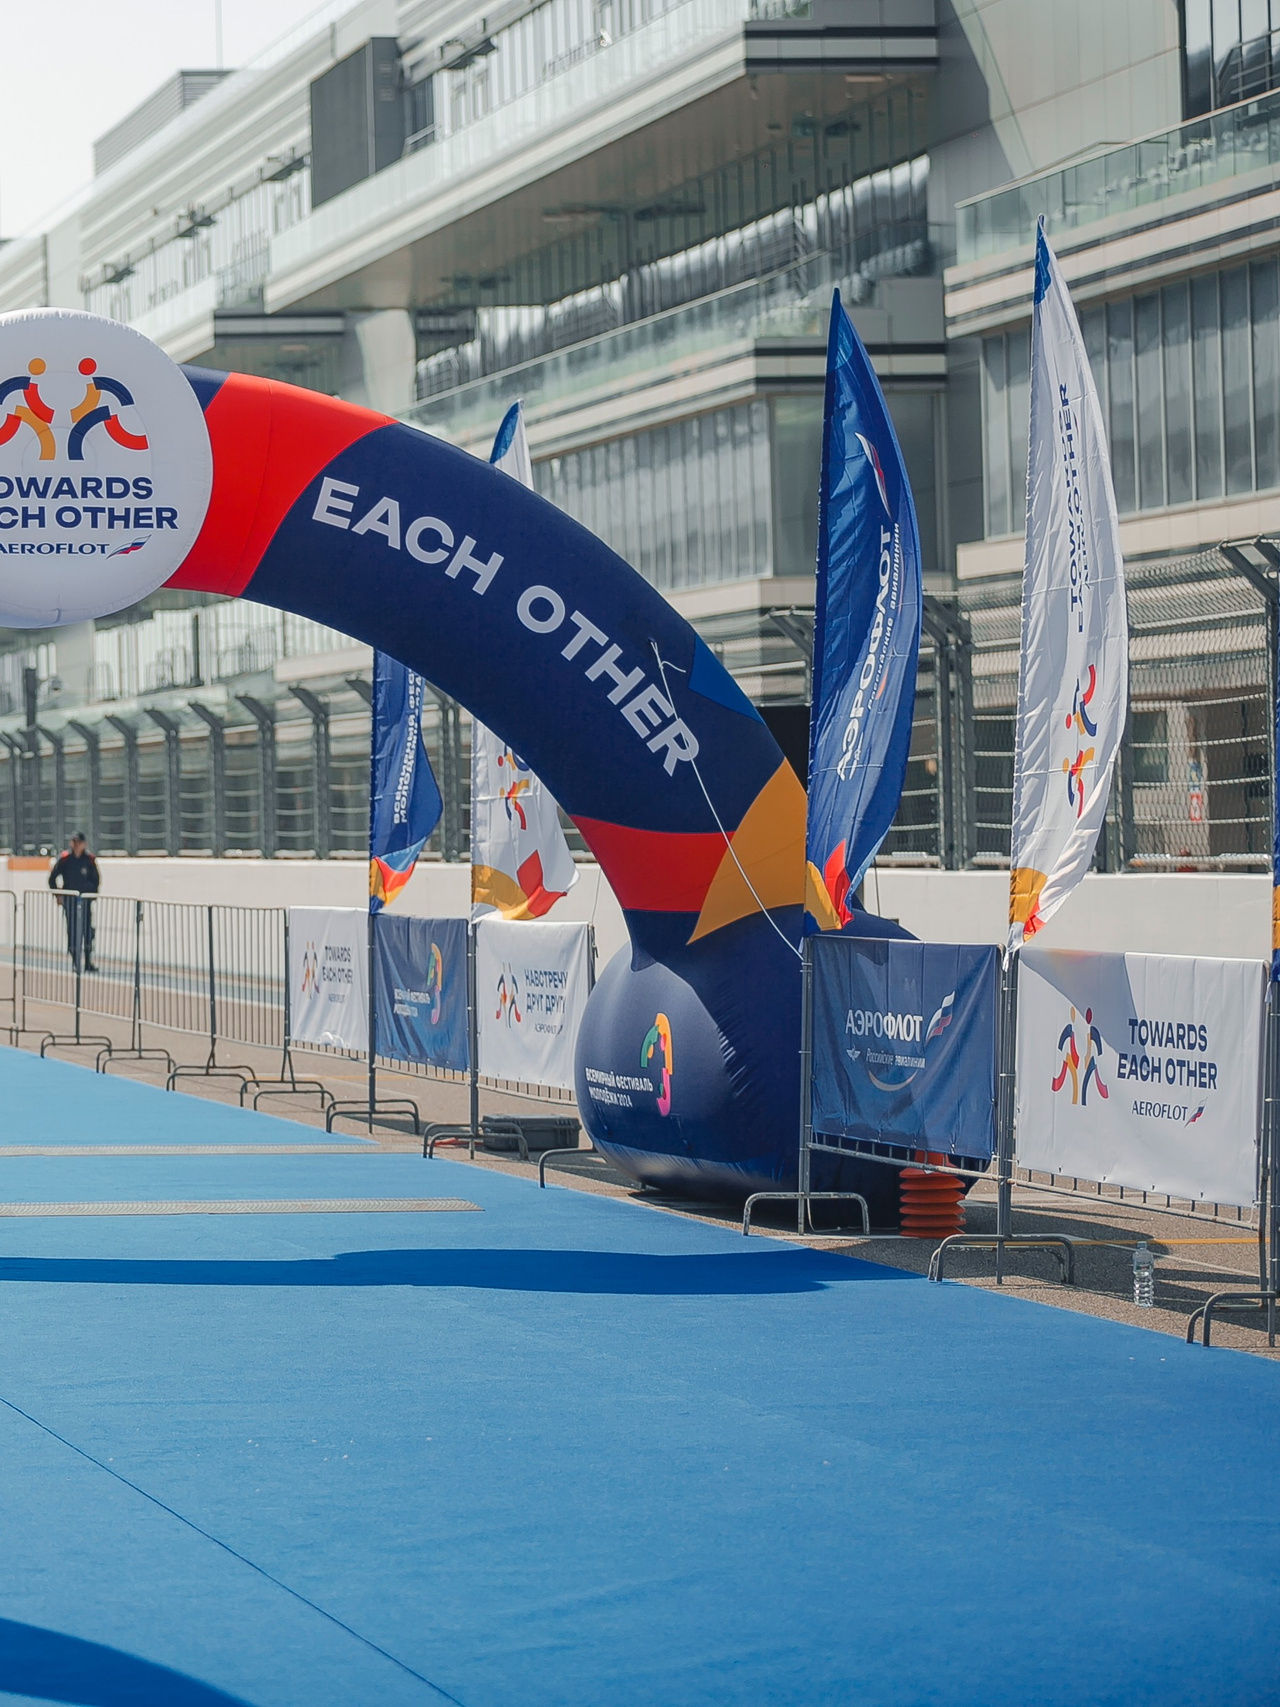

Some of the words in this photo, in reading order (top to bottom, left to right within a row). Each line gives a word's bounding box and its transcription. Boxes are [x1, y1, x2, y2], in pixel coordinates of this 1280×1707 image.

[55, 506, 179, 531] OTHER
[890, 522, 901, 611] авиалинии
[311, 476, 505, 596] EACH
[515, 584, 700, 777] OTHER
[836, 524, 891, 781] АЭРОФЛОТ
[524, 968, 568, 989] НАВСТРЕЧУ
[845, 1009, 923, 1042] АЭРОФЛОТ
[1128, 1018, 1208, 1052] TOWARDS
[616, 1074, 654, 1093] ФЕСТИВАЛЬ
[1117, 1052, 1162, 1083] EACH
[1165, 1057, 1218, 1090] OTHER
[1131, 1100, 1189, 1122] AEROFLOT
